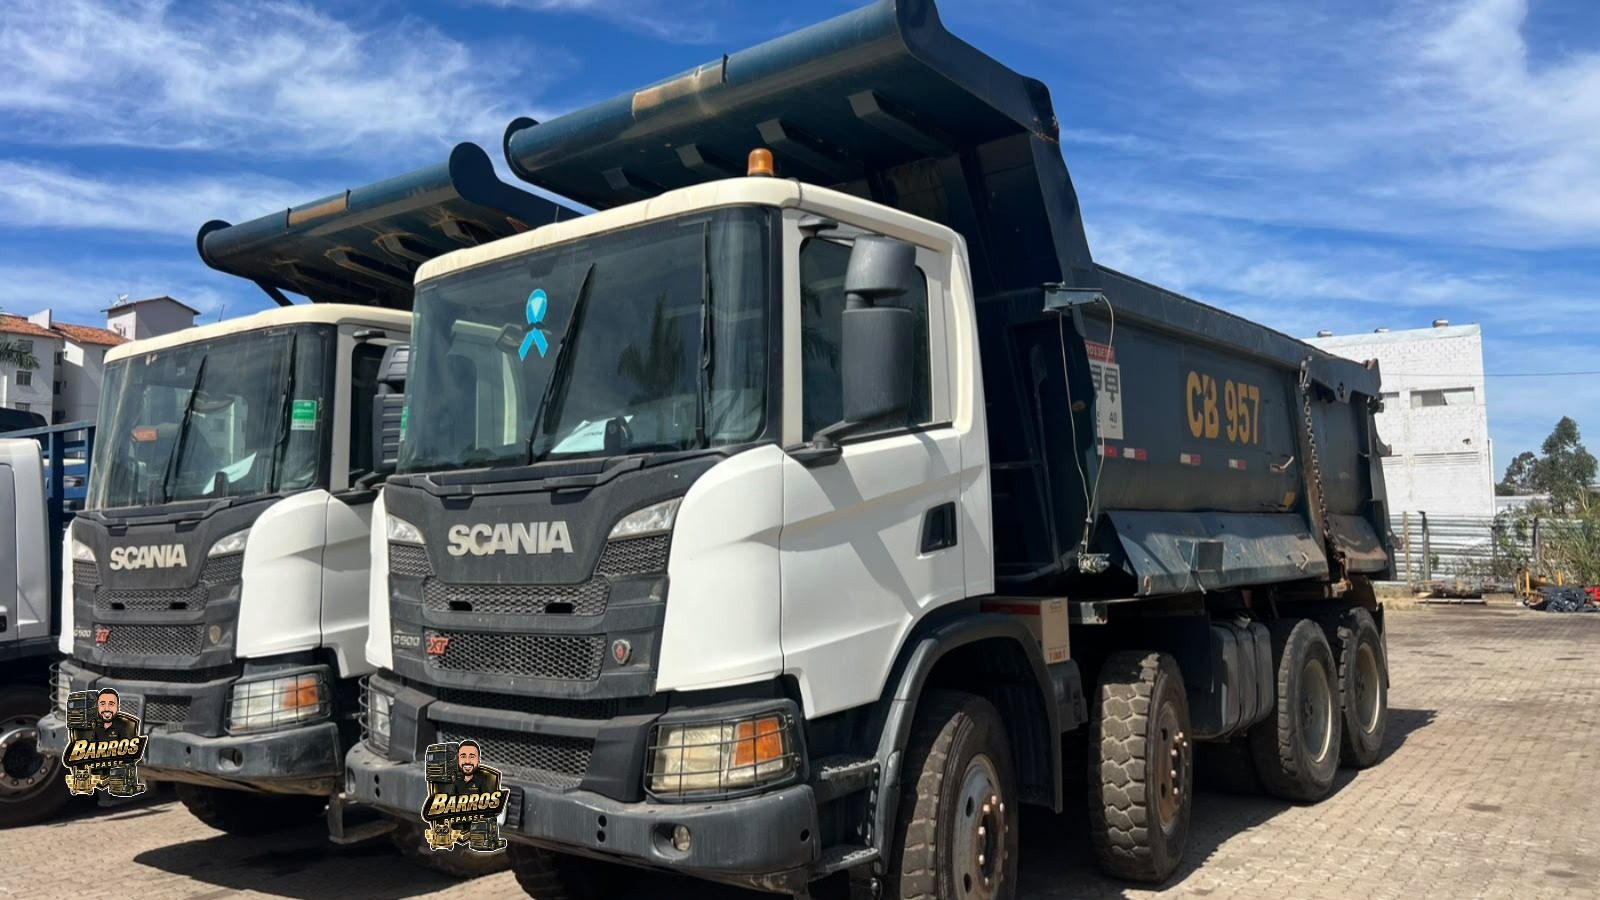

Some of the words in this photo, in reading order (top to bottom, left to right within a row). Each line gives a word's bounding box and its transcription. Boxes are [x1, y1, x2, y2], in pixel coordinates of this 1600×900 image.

[1186, 371, 1219, 438] CB
[1225, 379, 1260, 444] 957
[446, 521, 574, 556] SCANIA
[109, 544, 188, 570] SCANIA
[392, 634, 420, 647] G500
[427, 636, 449, 655] XT
